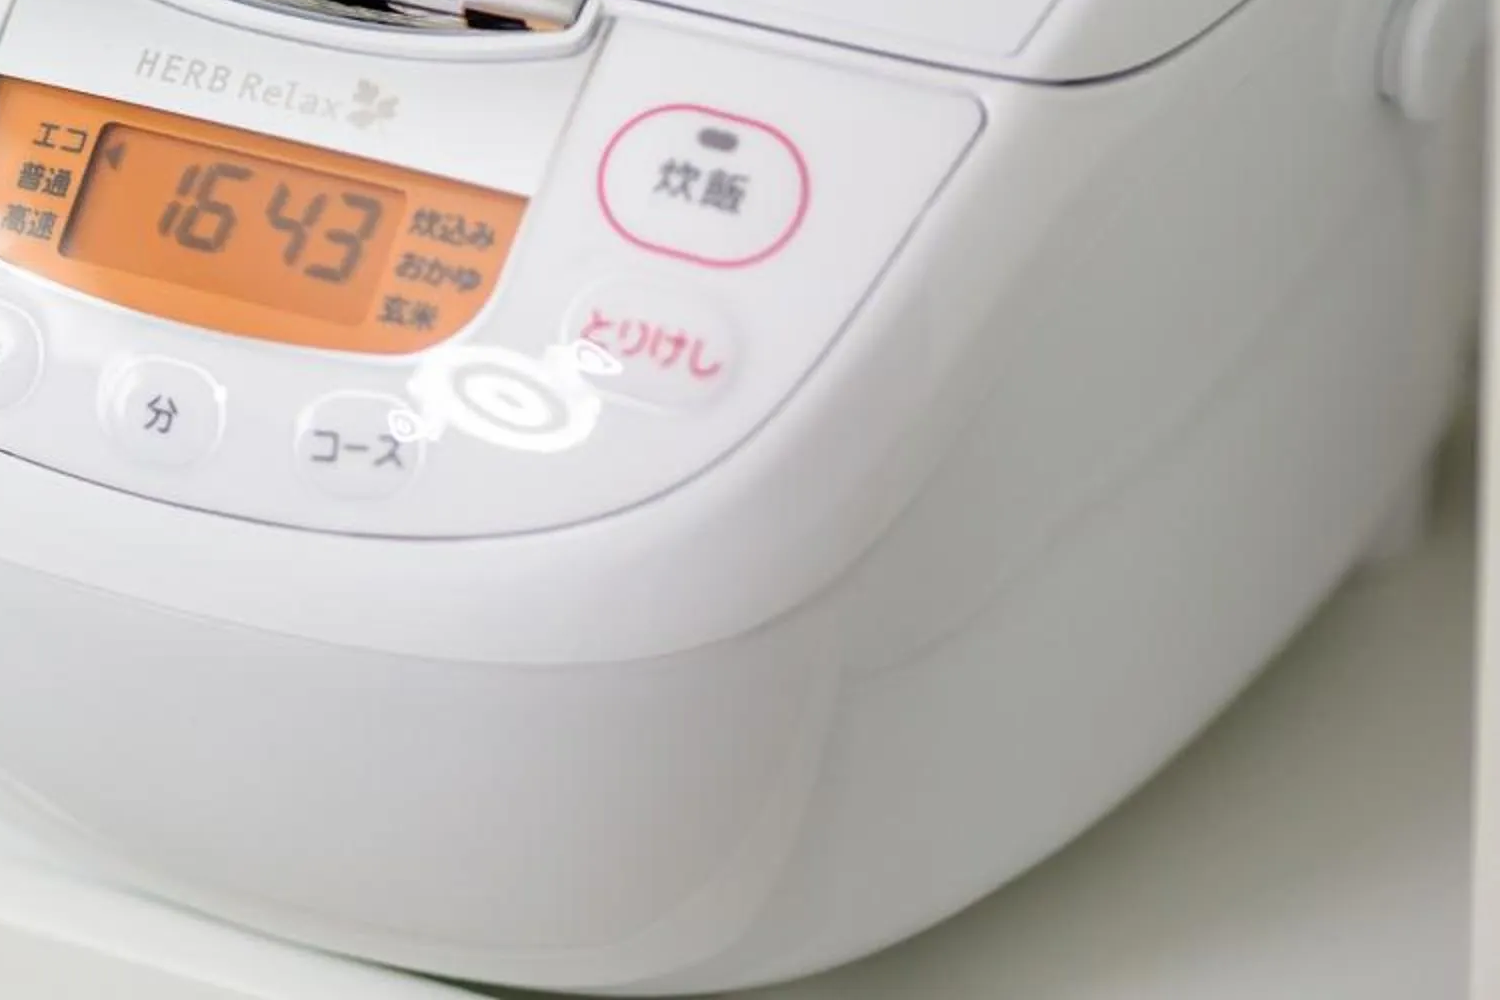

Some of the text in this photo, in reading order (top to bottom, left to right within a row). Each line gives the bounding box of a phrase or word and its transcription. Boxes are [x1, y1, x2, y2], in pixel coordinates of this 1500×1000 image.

[135, 49, 345, 121] HERB Relax
[32, 122, 88, 154] エコ
[17, 162, 71, 197] 普通
[653, 158, 750, 215] 炊飯
[1, 204, 57, 240] 高速
[395, 252, 482, 291] おかゆ
[580, 310, 722, 379] とりけし
[144, 395, 179, 434] 分
[309, 429, 405, 469] コース
